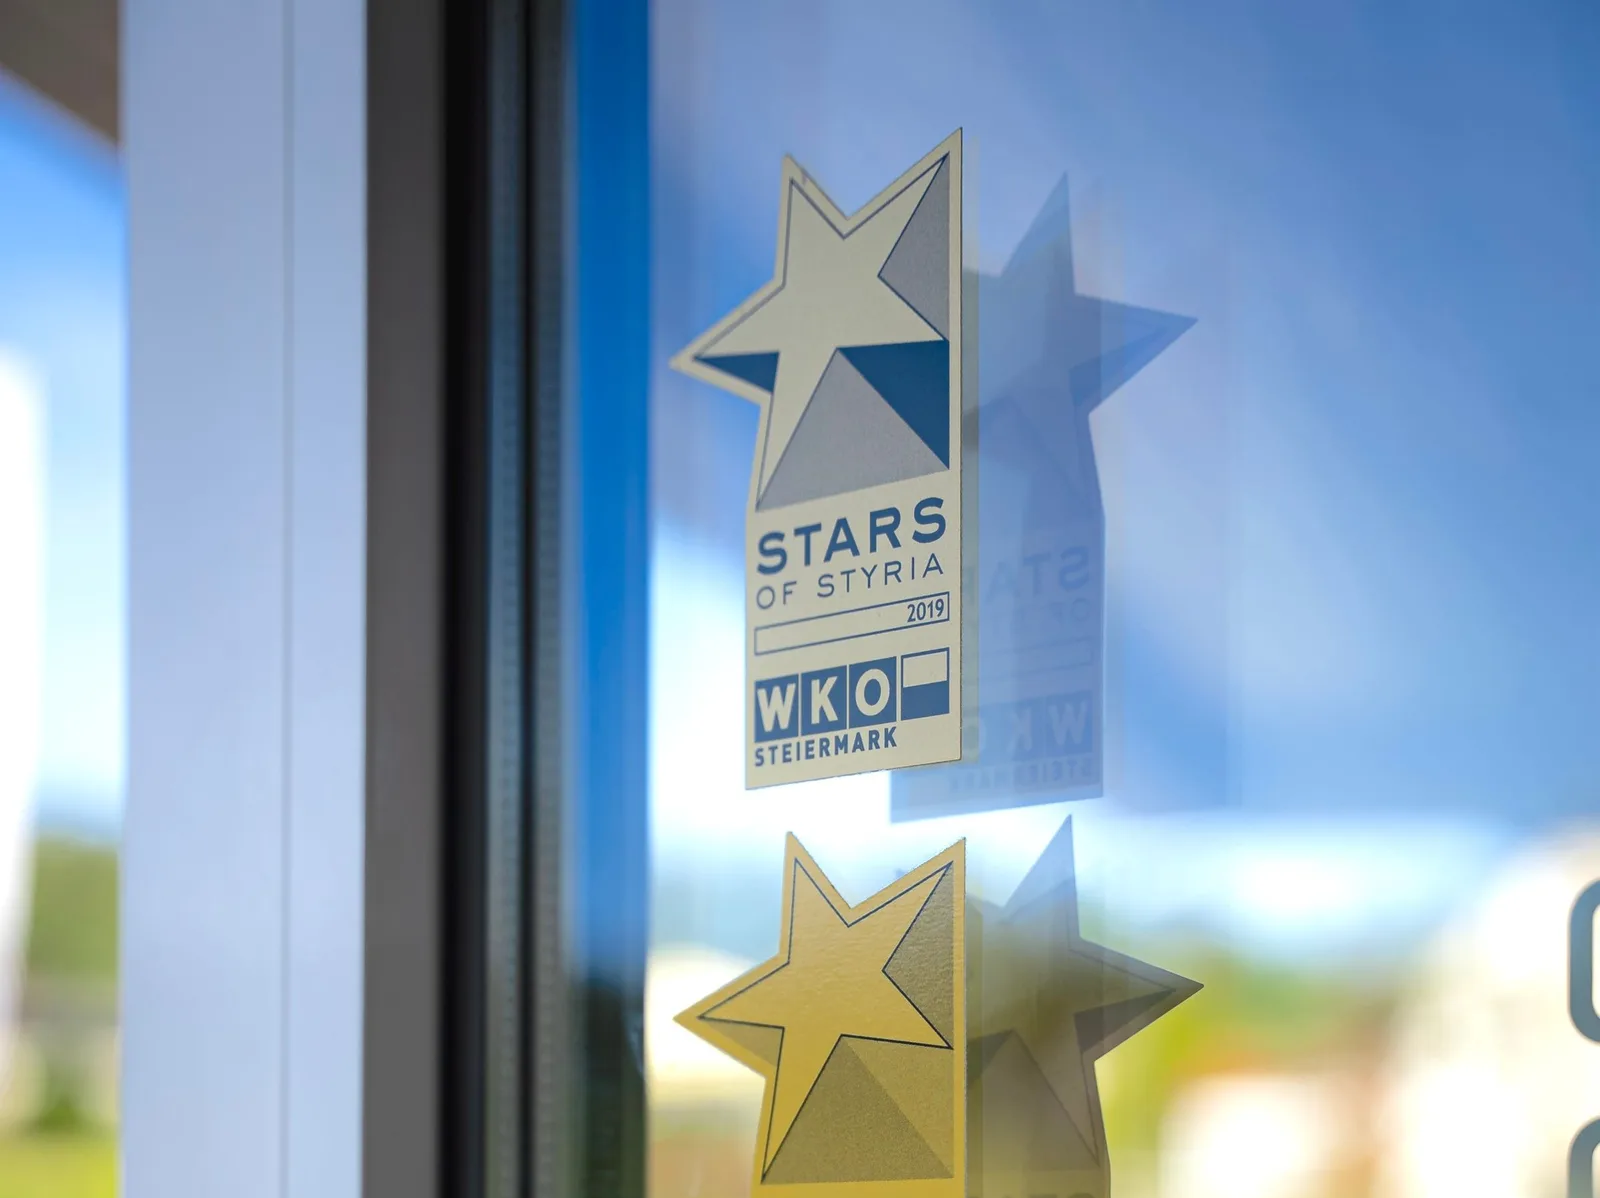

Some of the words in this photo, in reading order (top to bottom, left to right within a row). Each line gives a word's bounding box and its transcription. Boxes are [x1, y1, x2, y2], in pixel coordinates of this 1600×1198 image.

[757, 497, 946, 575] STARS
[757, 581, 797, 610] OF
[817, 553, 944, 598] STYRIA
[906, 599, 945, 623] 2019
[755, 667, 891, 732] WKO
[754, 726, 897, 767] STEIERMARK
